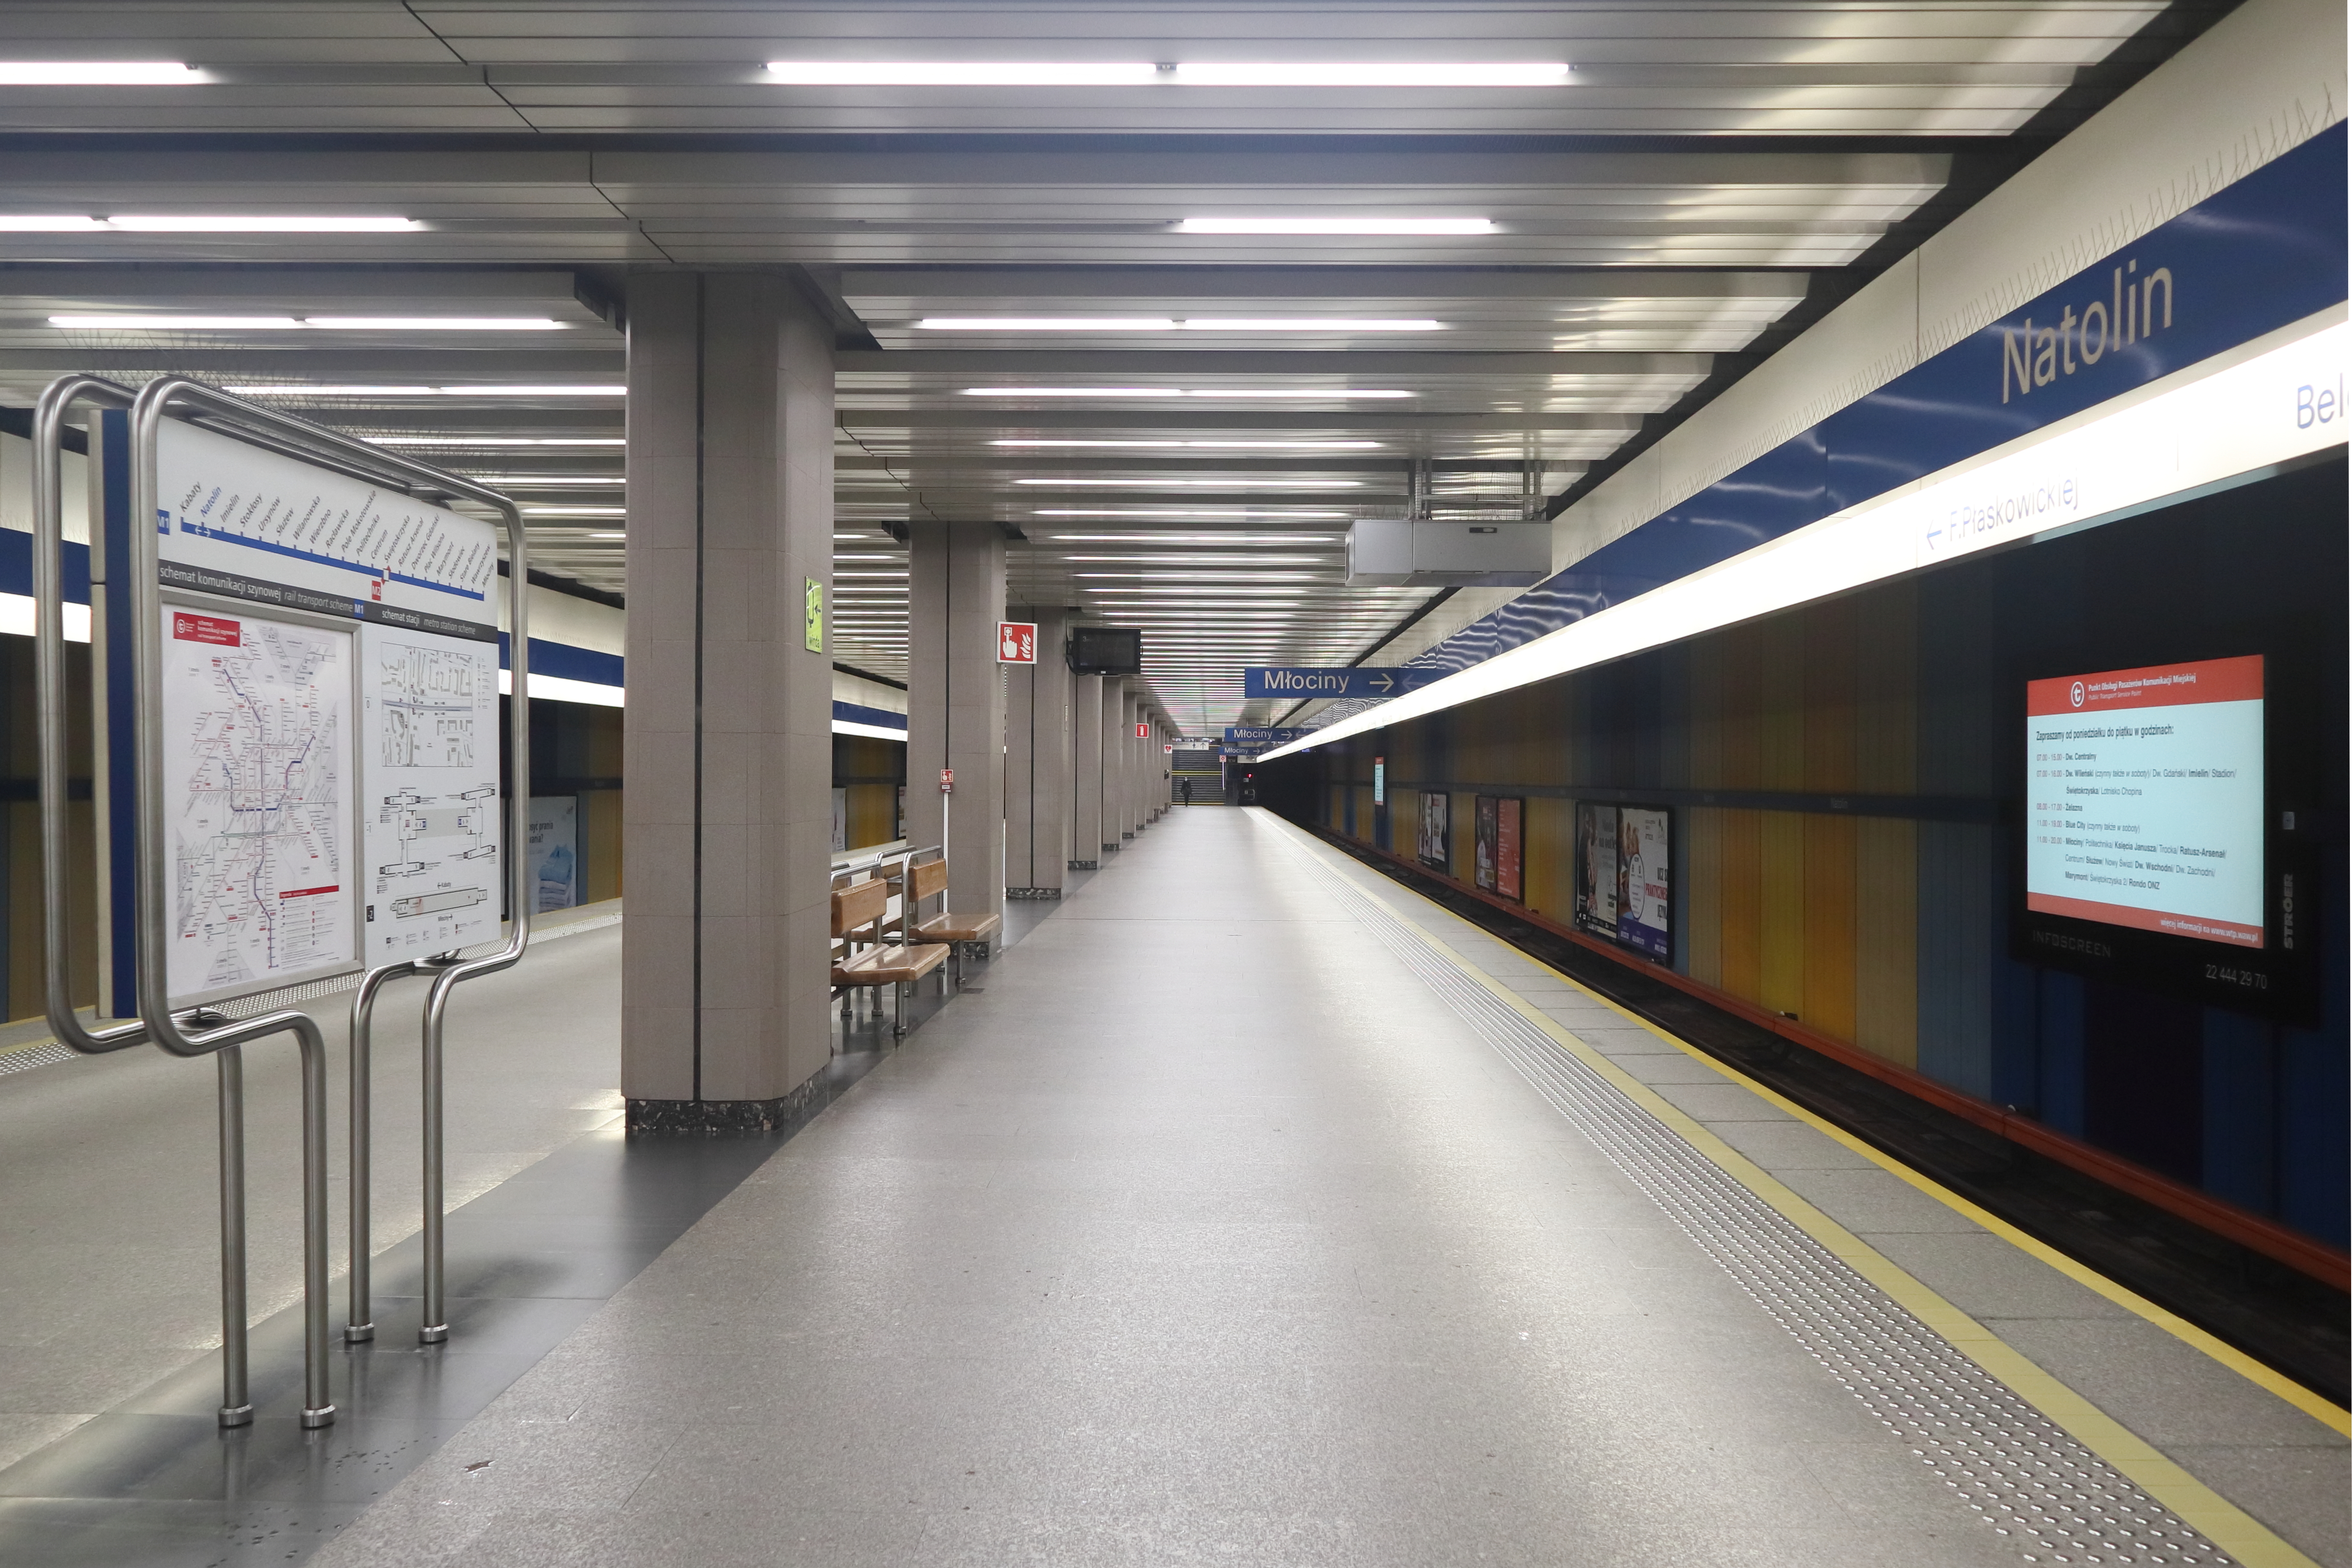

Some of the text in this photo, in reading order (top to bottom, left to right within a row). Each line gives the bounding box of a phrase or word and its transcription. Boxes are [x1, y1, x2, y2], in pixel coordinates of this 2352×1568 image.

[2003, 258, 2172, 404] Natolin
[2297, 372, 2349, 429] Bel
[180, 481, 201, 512] Kabaty
[200, 486, 222, 518] Natolin
[220, 494, 240, 523] Imielin
[240, 493, 262, 527] Stokłosy
[157, 515, 169, 528] M1
[258, 496, 281, 532] Ursynów
[276, 507, 294, 536] Służew
[293, 496, 320, 540] Wilanowska
[309, 509, 331, 544] Wierzbno
[325, 509, 349, 549] Racławicka
[341, 490, 377, 553] Pole Mokotowskie
[356, 514, 380, 556] Politechnika
[371, 529, 388, 560] Centrum
[384, 515, 410, 564] Świętokrzyska
[398, 516, 424, 567] Ratusz Arsenał
[411, 513, 440, 570] Dworzec Gdański
[423, 532, 445, 574] Plac Wilsona
[436, 541, 455, 576] Marymont
[448, 546, 465, 579] Słodowiec
[460, 541, 481, 582] Stare Bielany
[470, 544, 491, 584] Wawrzyszew
[160, 566, 364, 614] schemat komunikacji szynowej rail transport scheme M1
[372, 585, 381, 596] M2
[481, 562, 494, 588] Młociny
[382, 610, 475, 635] schemat stacji metro station scheme
[809, 634, 820, 648] winda
[1265, 671, 1350, 694] Młociny
[2102, 681, 2118, 691] Obsługi
[2143, 676, 2172, 686] Komunikacji
[2173, 673, 2196, 684] Miejskiej
[366, 700, 370, 708] 0
[1234, 729, 1272, 741] Młociny
[2036, 724, 2174, 743] Zapraszamy od poniedziałku do piątku w godzinach:
[2074, 753, 2097, 762] Centralny
[539, 820, 553, 833] prania
[2077, 821, 2086, 830] City
[2129, 879, 2146, 888] Rondo
[2147, 880, 2160, 890] ONZ
[368, 910, 373, 920] -2
[2161, 918, 2176, 930] więcej
[2177, 920, 2202, 934] informacji
[2211, 927, 2258, 943] www.wtp.waw.pl
[2033, 930, 2111, 958] INFOSCREEN
[2206, 964, 2268, 989] 22 444 29 70
